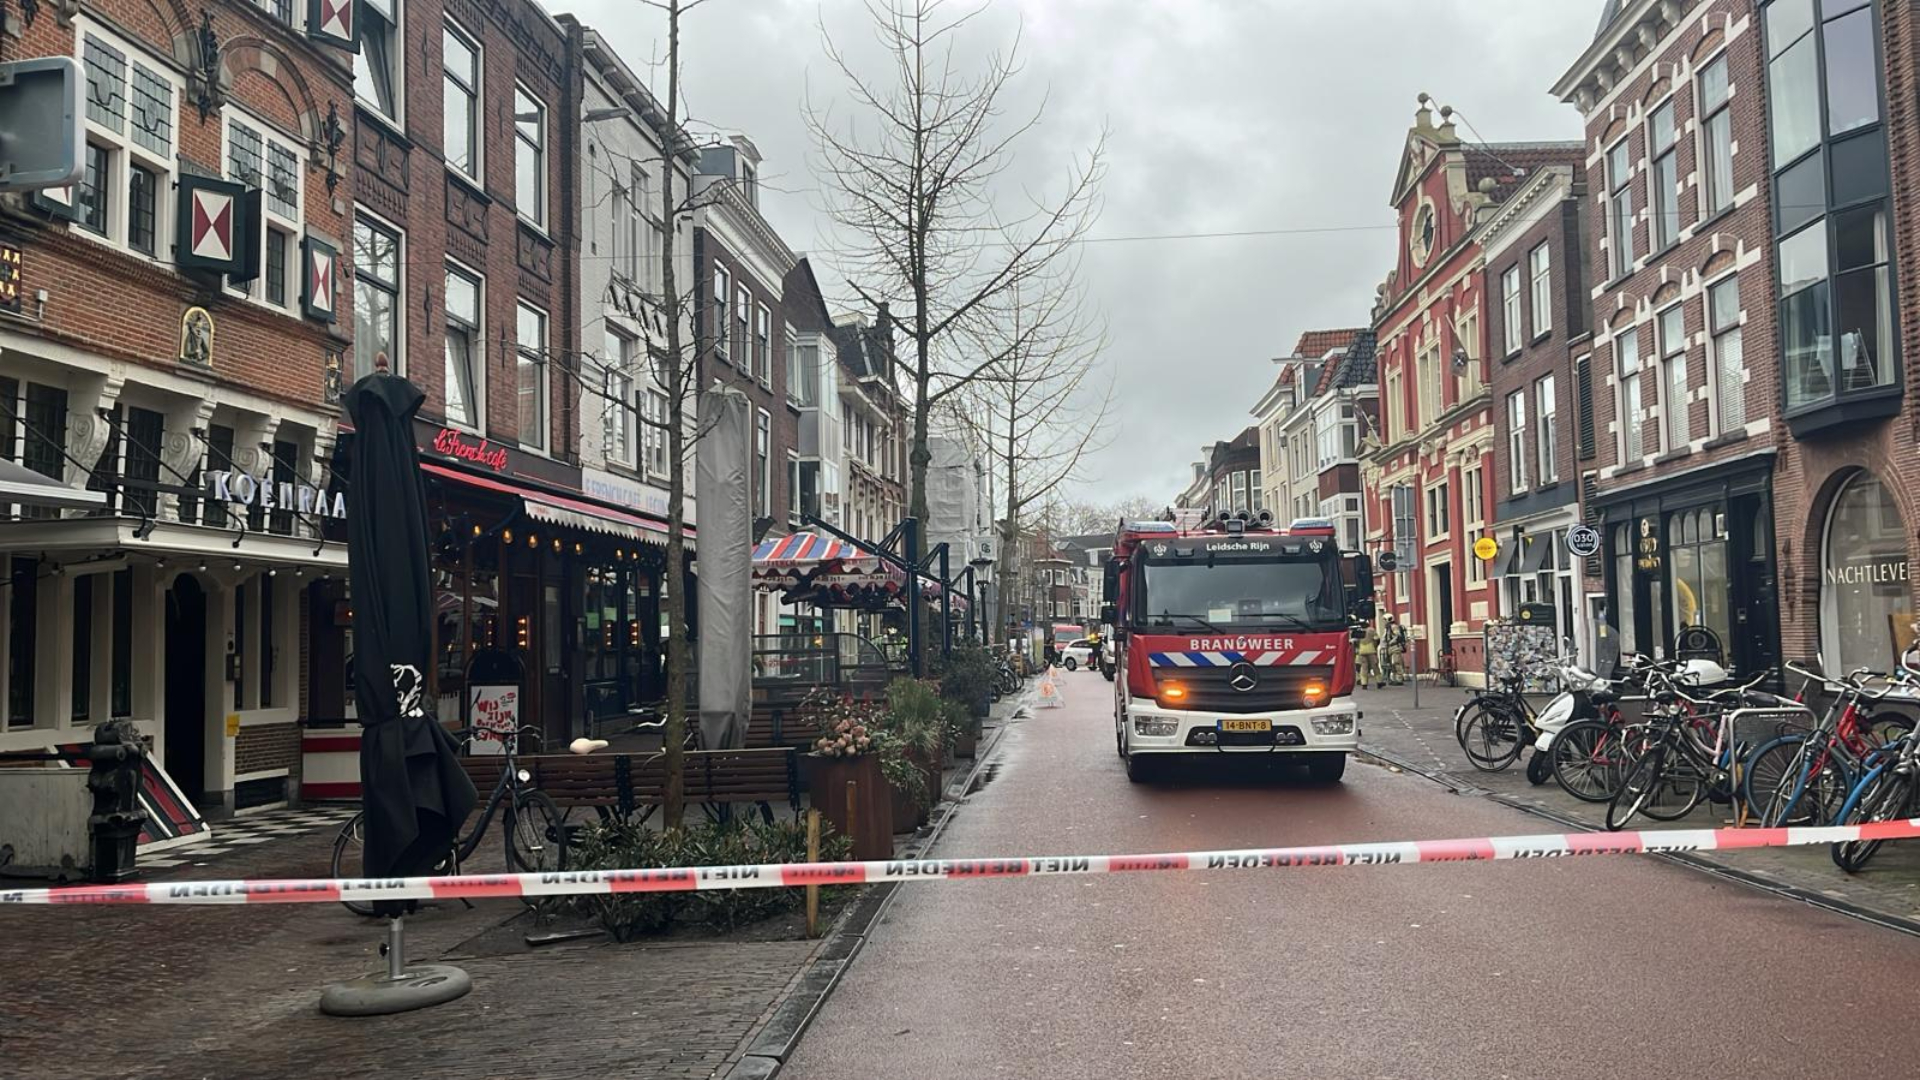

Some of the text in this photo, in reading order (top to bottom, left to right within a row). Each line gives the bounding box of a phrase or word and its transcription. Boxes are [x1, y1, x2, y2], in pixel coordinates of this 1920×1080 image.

[446, 427, 488, 463] French
[1573, 533, 1593, 543] 030
[1206, 542, 1270, 552] Leidsche Rijn
[1190, 637, 1294, 650] BRANDWEER
[477, 699, 499, 712] WIJ
[1225, 721, 1267, 730] 14-BNT-8
